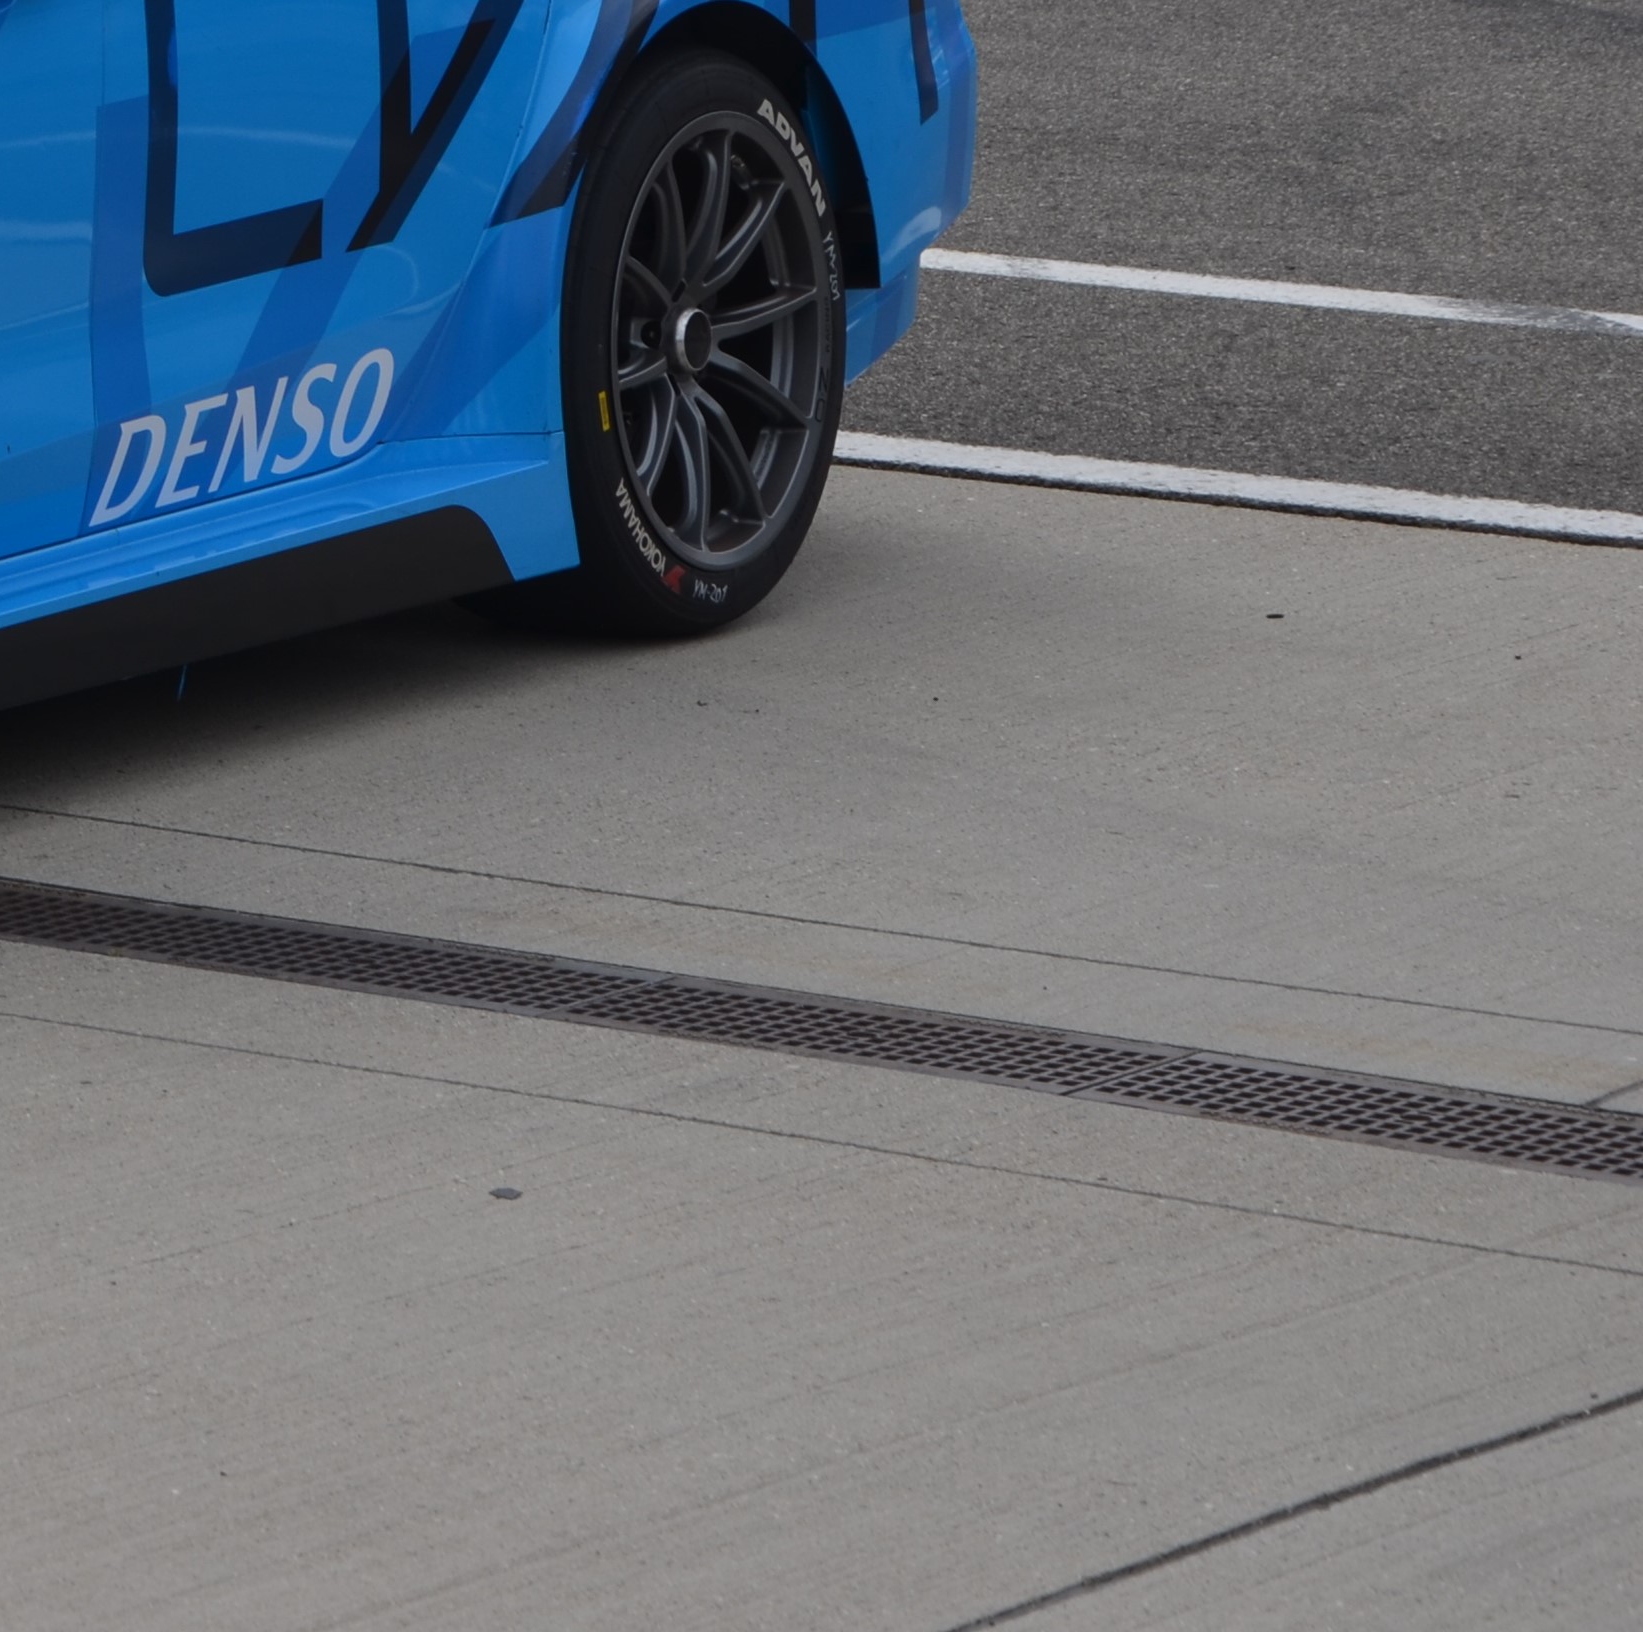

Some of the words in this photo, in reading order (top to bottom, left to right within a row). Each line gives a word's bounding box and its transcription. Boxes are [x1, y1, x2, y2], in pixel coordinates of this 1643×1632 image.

[756, 97, 827, 219] ADVAN
[87, 347, 396, 529] DENSO
[616, 477, 667, 577] YOKOHAMA
